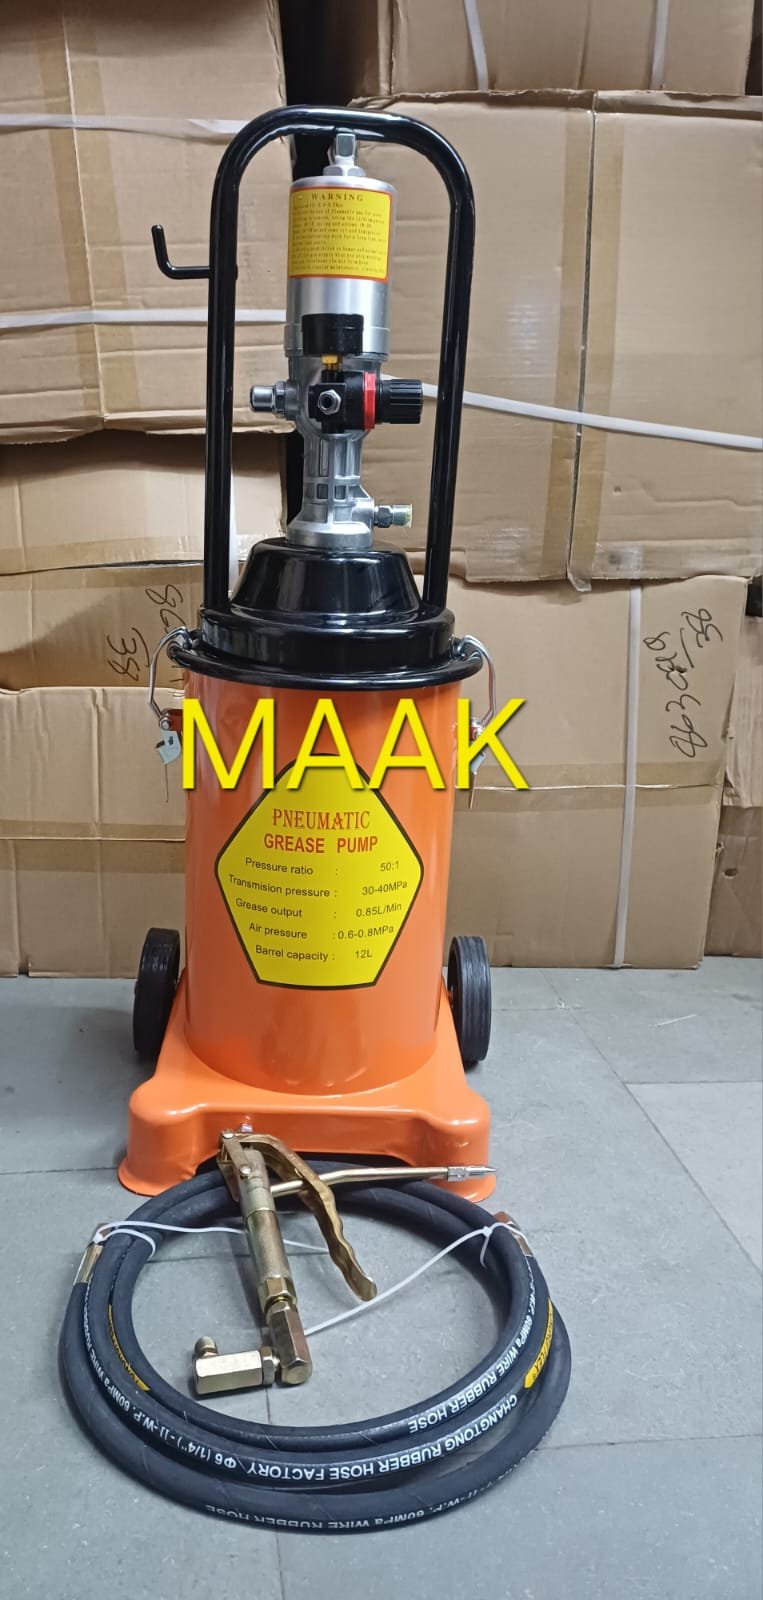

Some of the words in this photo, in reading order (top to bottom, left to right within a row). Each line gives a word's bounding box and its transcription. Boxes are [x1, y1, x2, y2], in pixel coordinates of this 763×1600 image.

[311, 193, 364, 201] WARNING
[272, 808, 371, 830] PNEUMATIC
[263, 833, 325, 853] GREASE
[336, 835, 378, 854] PUMP
[245, 857, 288, 873] Pressure
[290, 867, 314, 875] ratio
[379, 861, 400, 872] 50:1
[228, 873, 283, 894] Transmision
[285, 884, 330, 898] pressure
[361, 880, 408, 896] 30-40MPa
[235, 898, 268, 913] Grease
[270, 907, 303, 918] output
[355, 903, 402, 918] 0.85L/Min
[249, 922, 262, 933] Air
[264, 926, 308, 940] pressure
[337, 925, 394, 940] 0.6-0.8MPa
[255, 944, 284, 957] Barrel
[286, 949, 329, 962] capacity
[355, 949, 373, 960] 12L
[496, 1346, 519, 1377] WIRE
[447, 1375, 498, 1414] RUBBER
[407, 1409, 448, 1434] HOSE
[445, 1394, 518, 1452] CHANGTONG
[378, 1443, 442, 1474] RUBBER
[247, 1462, 324, 1481] FACTORY
[329, 1465, 374, 1480] HOSE
